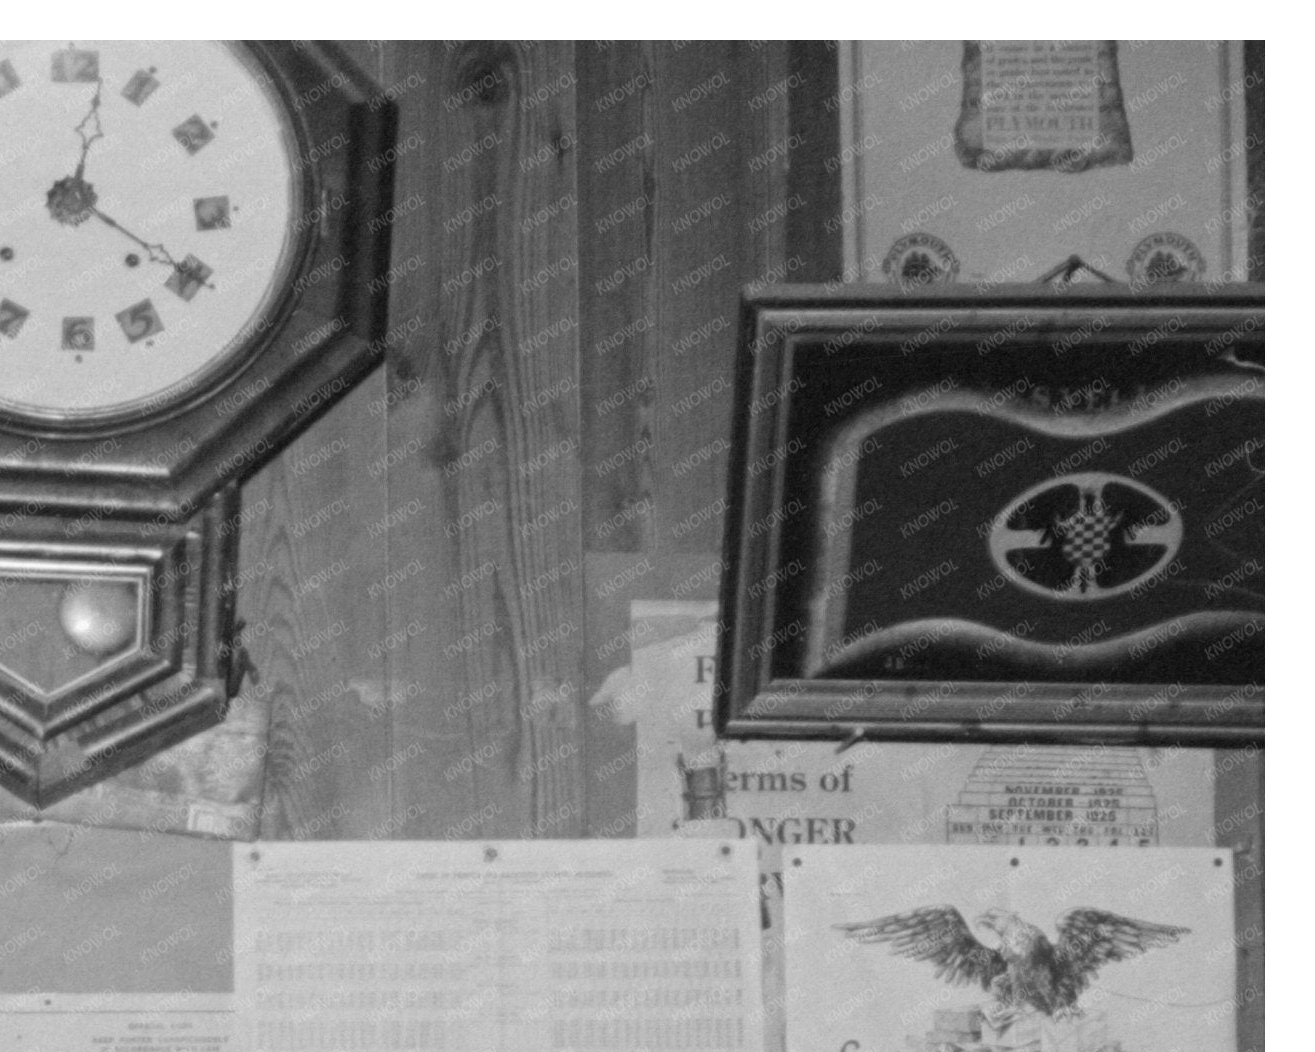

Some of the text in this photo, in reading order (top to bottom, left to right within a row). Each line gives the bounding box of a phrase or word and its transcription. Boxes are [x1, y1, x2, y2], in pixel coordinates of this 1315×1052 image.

[723, 764, 854, 793] erms of
[1005, 785, 1080, 794] NOVEMBER
[1008, 797, 1074, 808] OCTOBER
[988, 808, 1073, 821] SEPTEMBER
